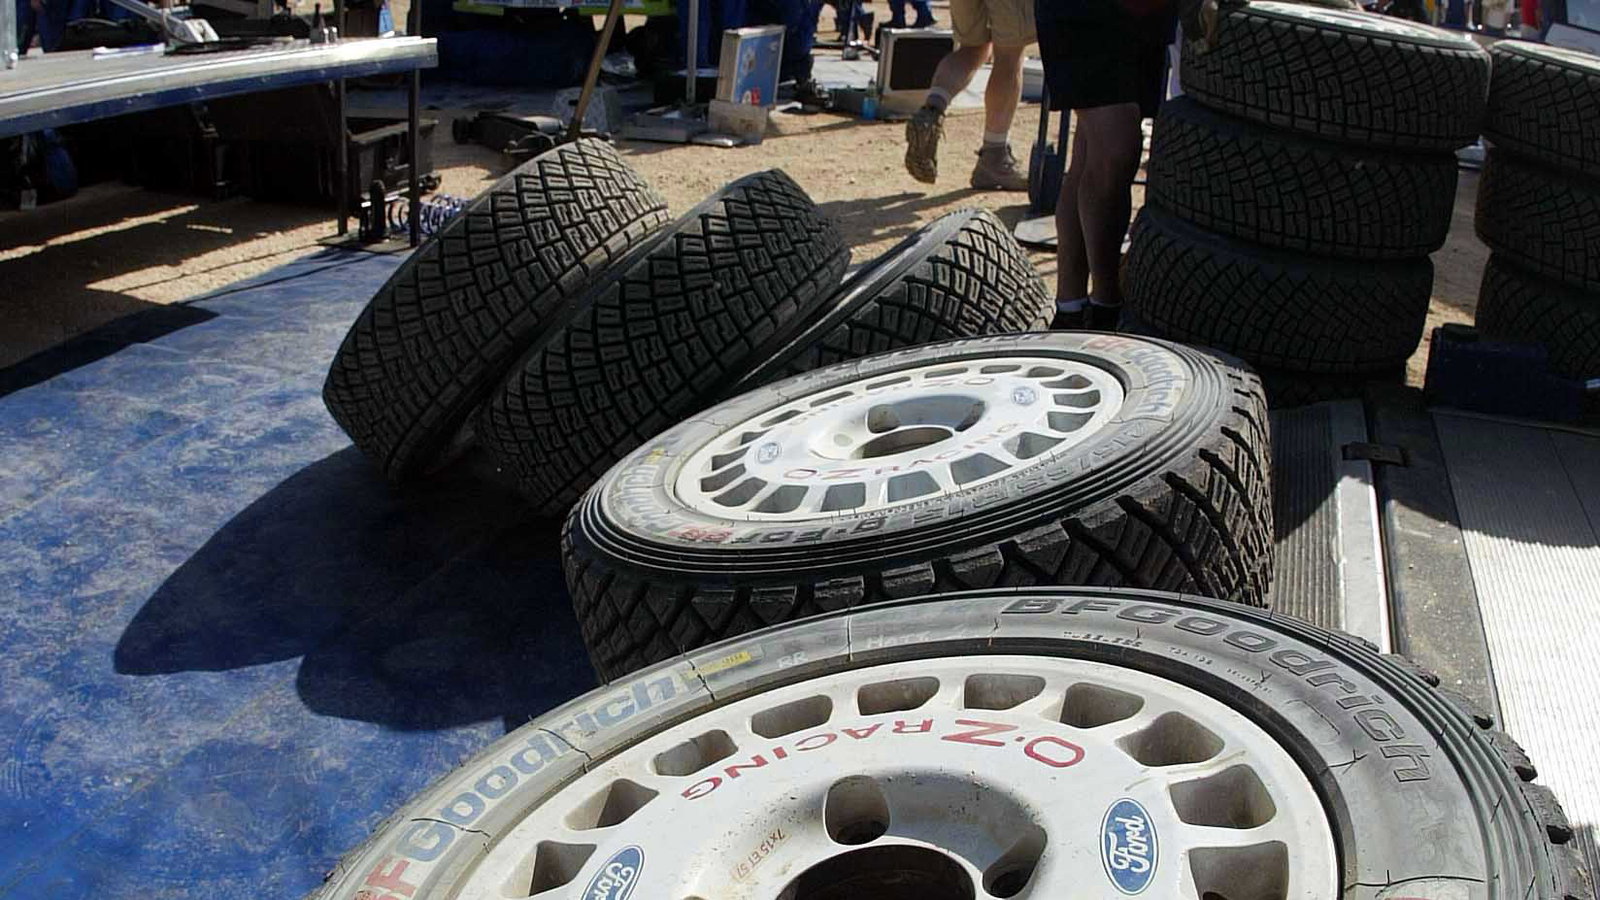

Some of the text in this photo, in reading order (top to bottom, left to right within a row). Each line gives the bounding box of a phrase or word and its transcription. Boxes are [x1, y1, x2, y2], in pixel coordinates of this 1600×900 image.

[1001, 597, 1430, 783] BFGoodrich
[355, 675, 678, 900] FGoodrich
[681, 719, 1086, 800] O.Z RACING
[749, 849, 763, 868] ET
[1109, 815, 1150, 873] Ford
[592, 862, 635, 900] For
